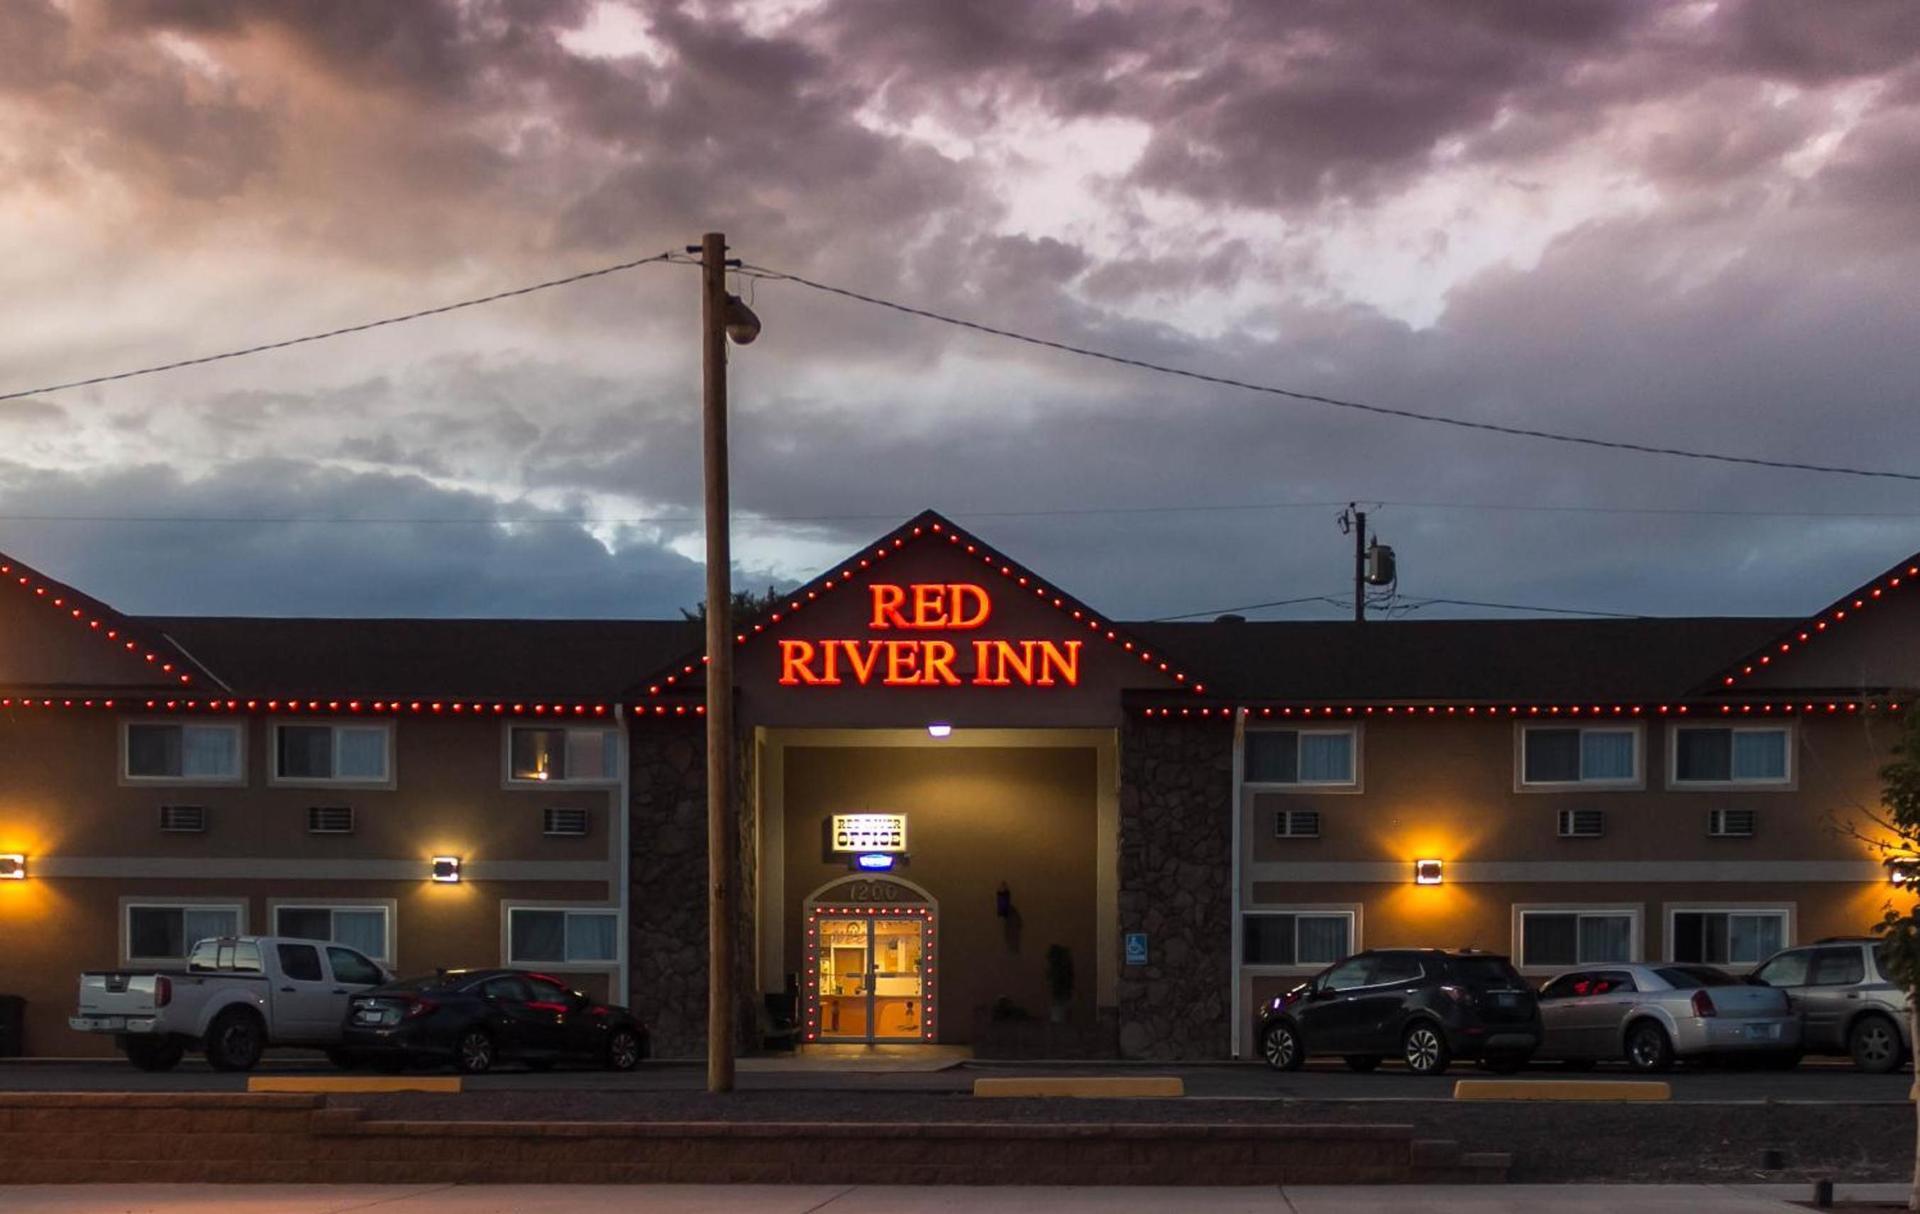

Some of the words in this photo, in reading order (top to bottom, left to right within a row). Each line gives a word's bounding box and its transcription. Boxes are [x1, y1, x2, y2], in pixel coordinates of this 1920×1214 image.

[869, 584, 992, 630] RED
[779, 640, 962, 686] RIVER
[972, 640, 1082, 687] INN
[838, 832, 900, 846] OFFICE
[850, 883, 898, 901] 1200
